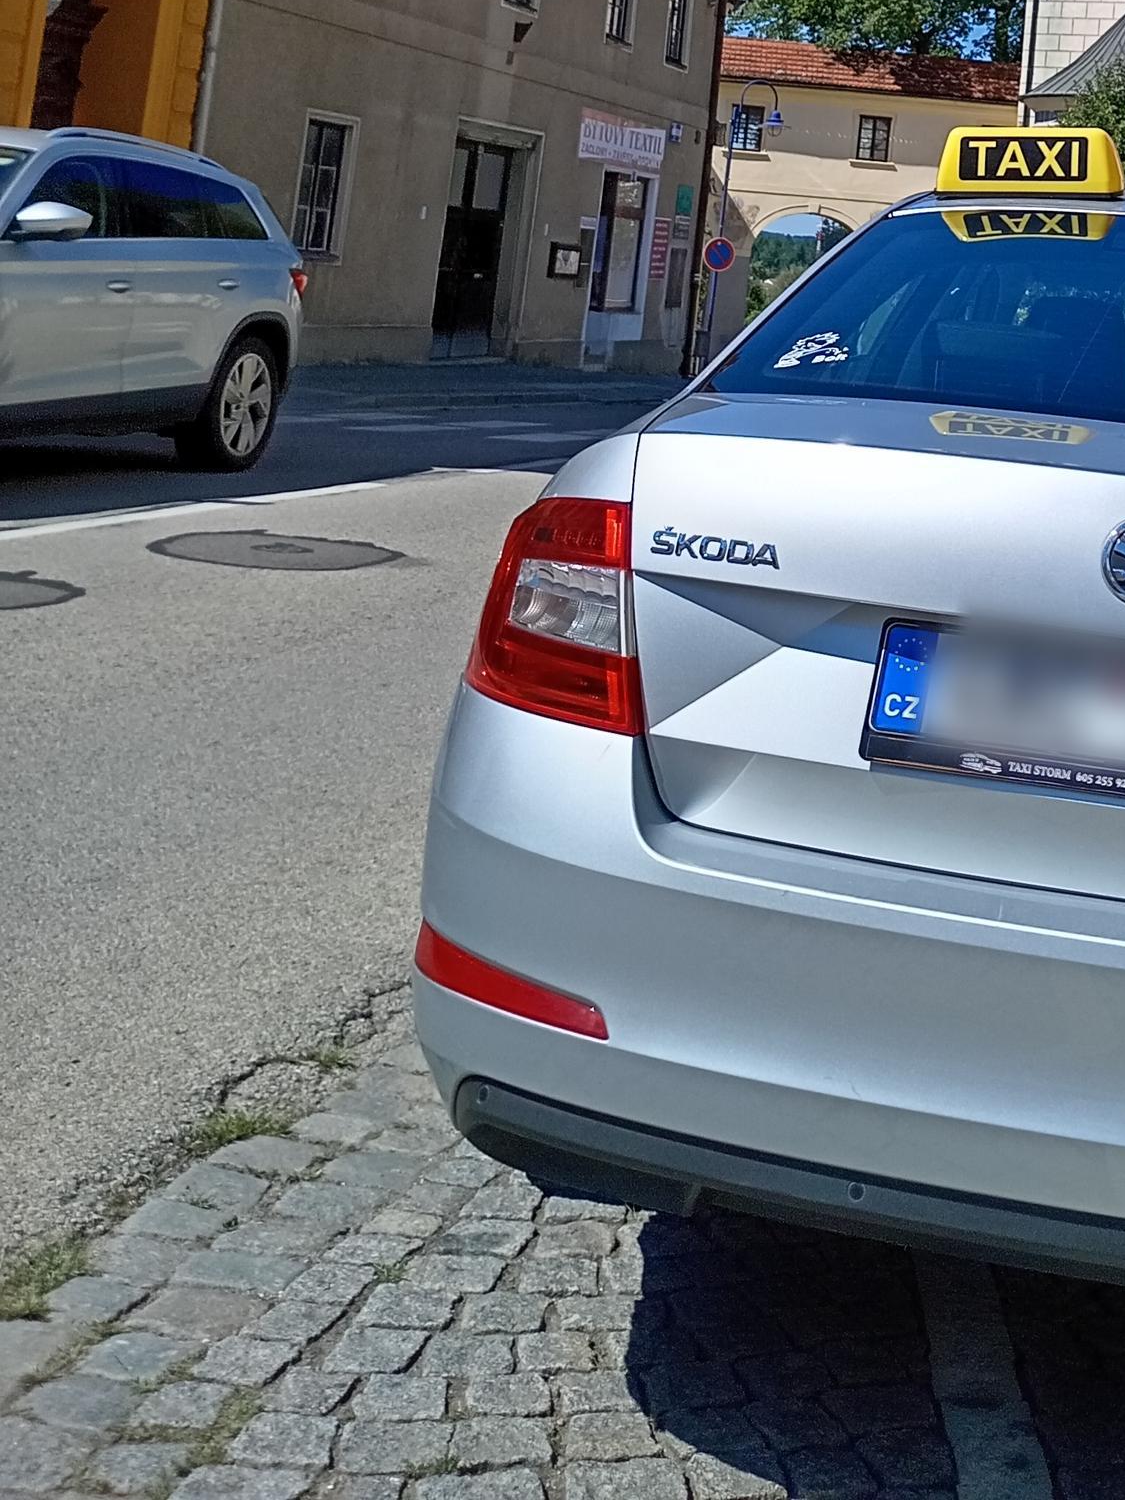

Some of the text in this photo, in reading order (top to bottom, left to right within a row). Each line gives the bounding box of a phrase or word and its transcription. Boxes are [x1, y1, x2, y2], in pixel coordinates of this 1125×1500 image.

[629, 130, 662, 156] TEXTIL
[968, 140, 1080, 178] TAXI
[650, 525, 781, 570] ŠKODA
[883, 693, 920, 719] CZ
[1008, 761, 1032, 775] TAXI
[1033, 765, 1071, 780] STORM
[1076, 772, 1094, 784] 605
[1095, 775, 1113, 787] 255
